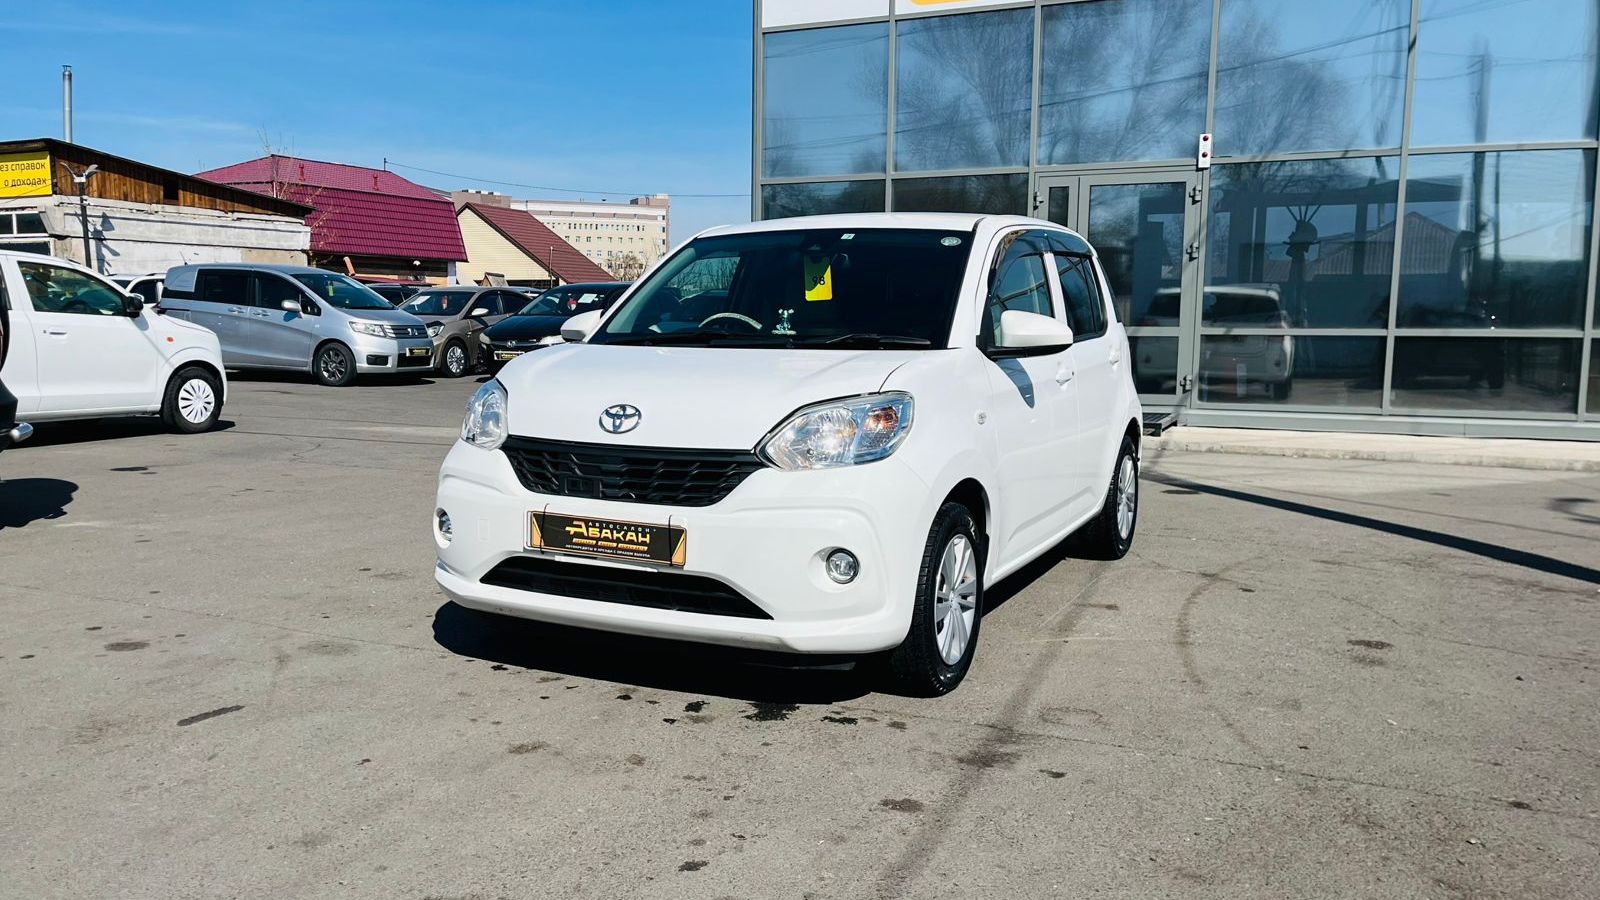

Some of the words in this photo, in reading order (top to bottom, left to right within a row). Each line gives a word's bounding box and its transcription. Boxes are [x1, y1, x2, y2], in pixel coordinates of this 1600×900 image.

[11, 162, 46, 173] справок
[4, 179, 9, 187] о
[11, 177, 47, 187] доходах
[812, 276, 826, 286] 98
[588, 521, 650, 533] АВТОСАЛОН
